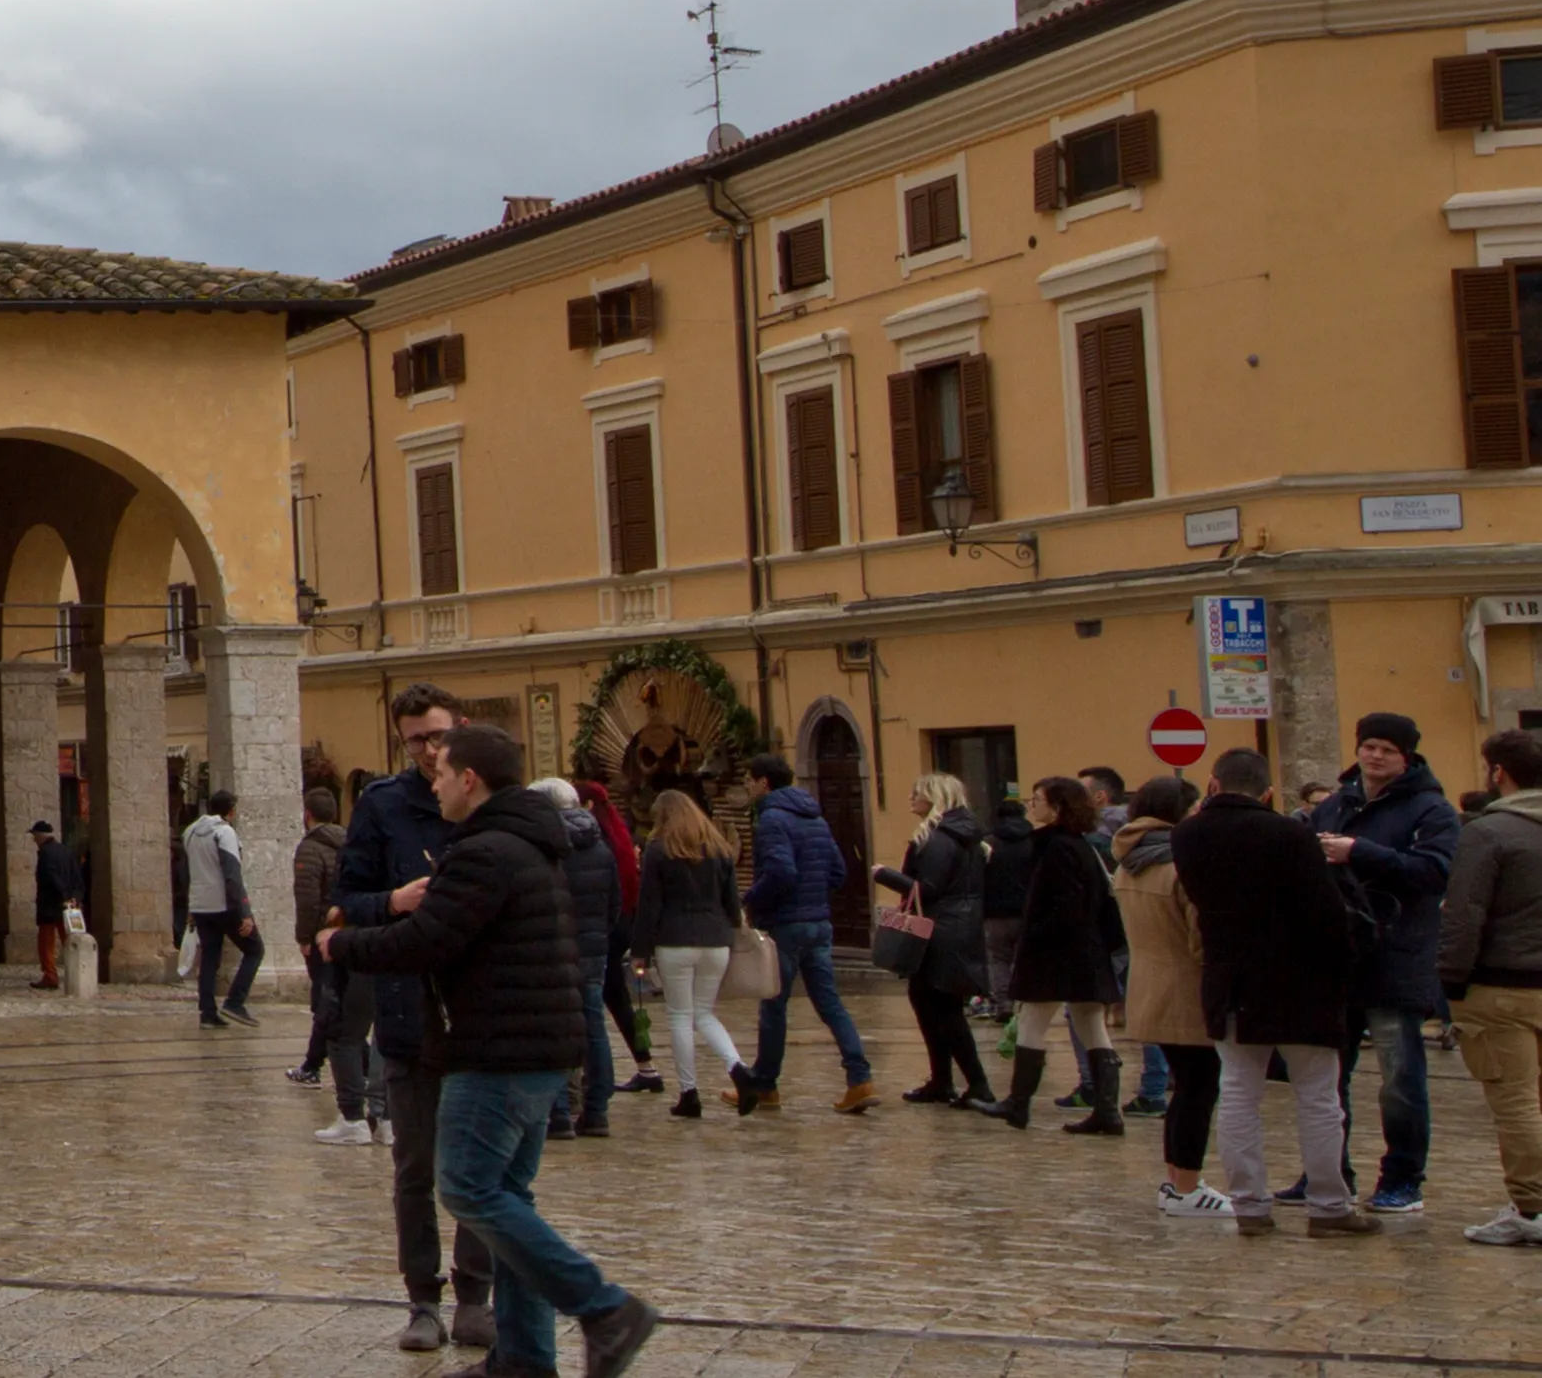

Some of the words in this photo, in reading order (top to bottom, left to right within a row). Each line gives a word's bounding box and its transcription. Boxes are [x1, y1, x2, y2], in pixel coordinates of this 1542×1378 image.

[1372, 509, 1390, 519] SAN
[1229, 600, 1256, 633] T
[1224, 638, 1265, 648] TABACCHI
